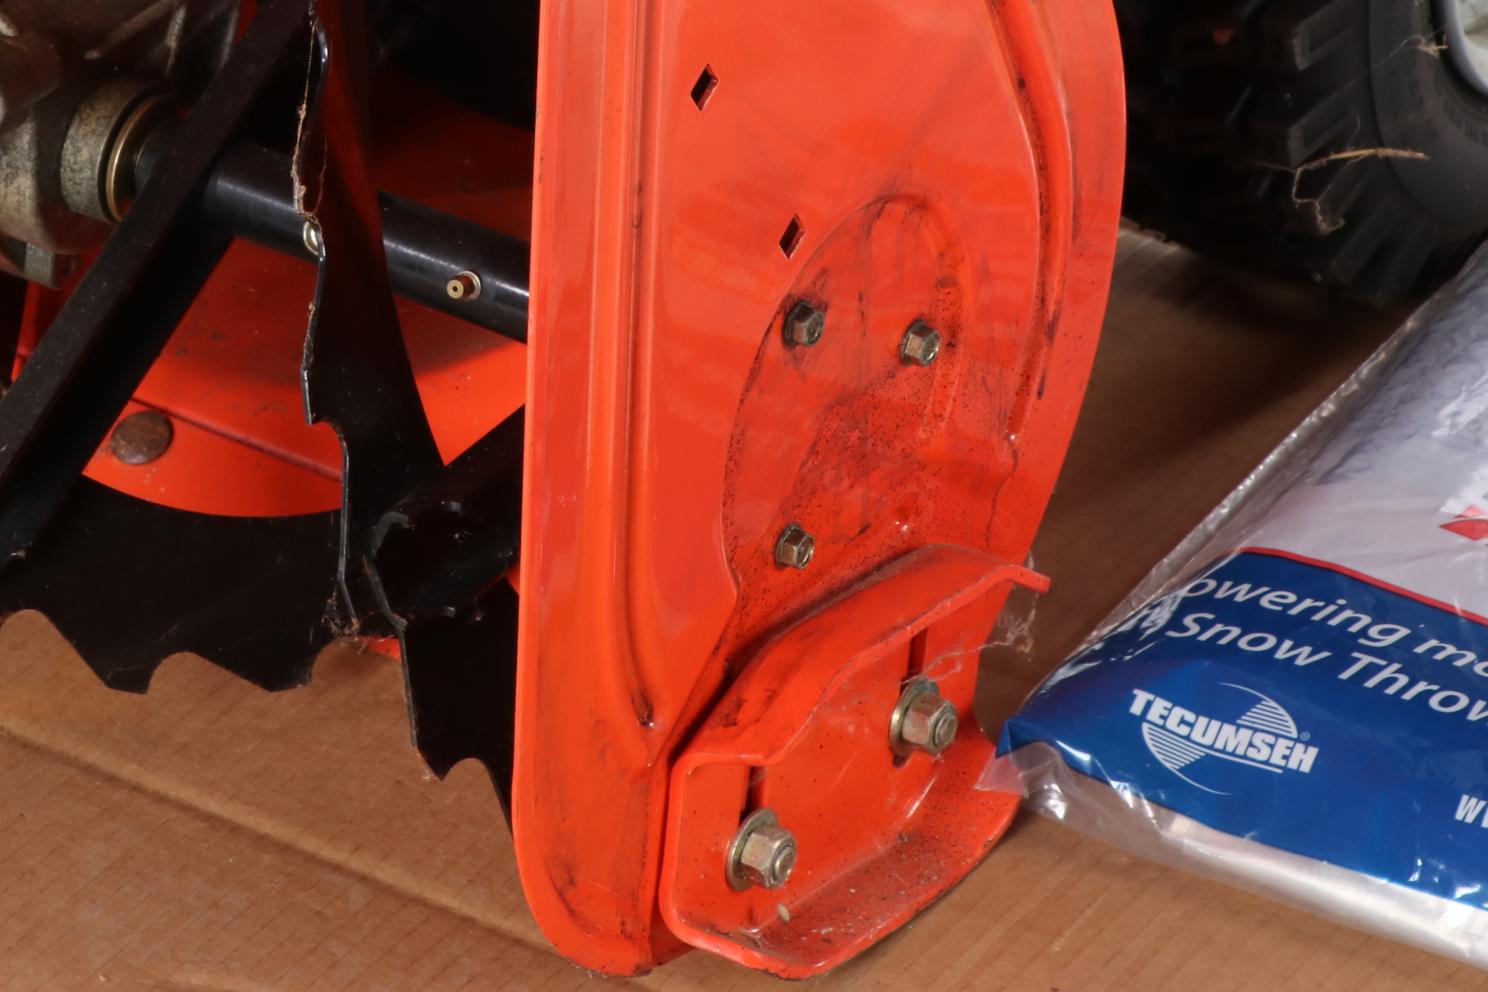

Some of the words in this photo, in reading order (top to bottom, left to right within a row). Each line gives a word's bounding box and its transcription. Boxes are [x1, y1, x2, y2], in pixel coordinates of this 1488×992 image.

[1165, 612, 1333, 667] Snow
[1183, 578, 1412, 647] owering
[1129, 688, 1319, 774] TECUMSEH
[1455, 793, 1488, 829] W
